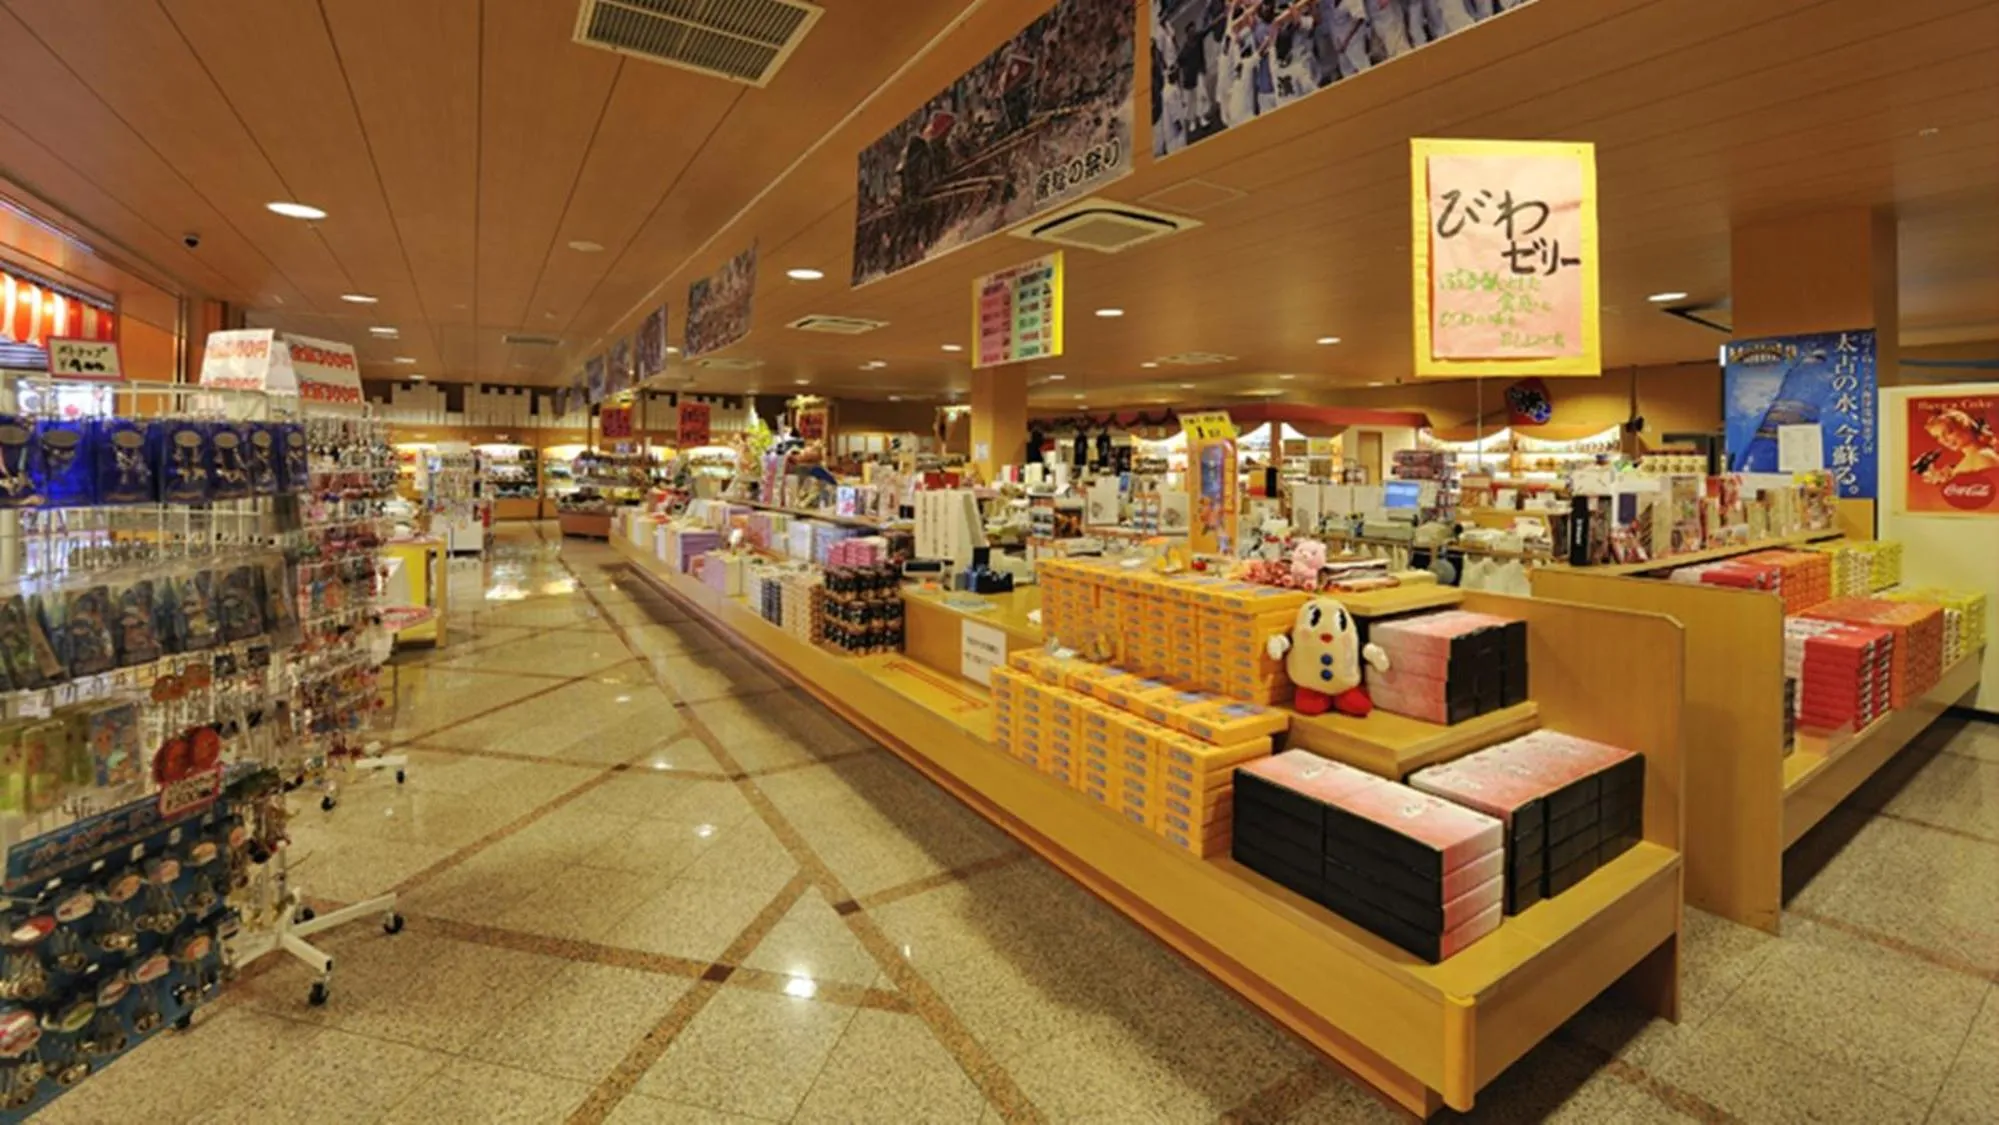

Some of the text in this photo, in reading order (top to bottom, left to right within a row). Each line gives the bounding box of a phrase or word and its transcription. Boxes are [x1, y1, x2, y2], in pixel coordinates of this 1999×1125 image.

[1437, 188, 1549, 241] びわ
[1502, 238, 1581, 276] ゼリー
[1832, 333, 1860, 494] 太古の水、今蘇る。
